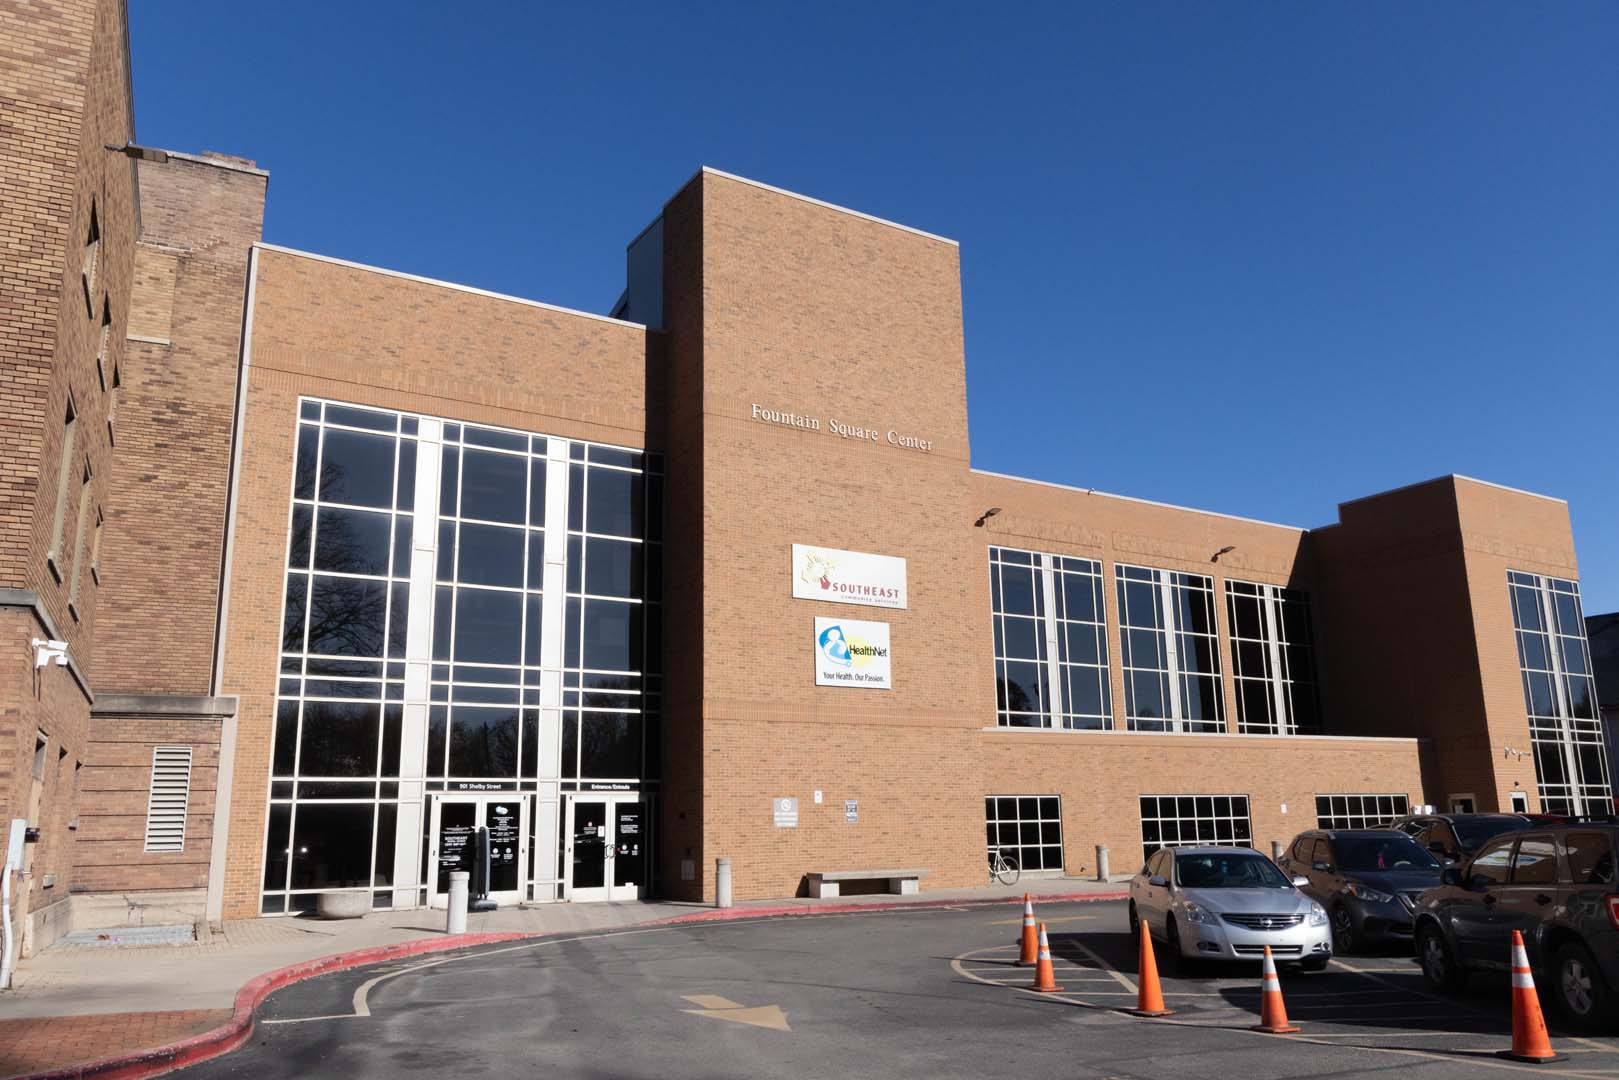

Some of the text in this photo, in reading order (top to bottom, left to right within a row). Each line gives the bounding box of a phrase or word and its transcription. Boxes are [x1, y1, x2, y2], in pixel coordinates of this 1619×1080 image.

[751, 403, 932, 451] Fountain Square Center
[832, 582, 899, 599] SOUTHEAST
[849, 644, 888, 658] HealthNet
[823, 671, 835, 680] Your
[855, 673, 865, 681] Our
